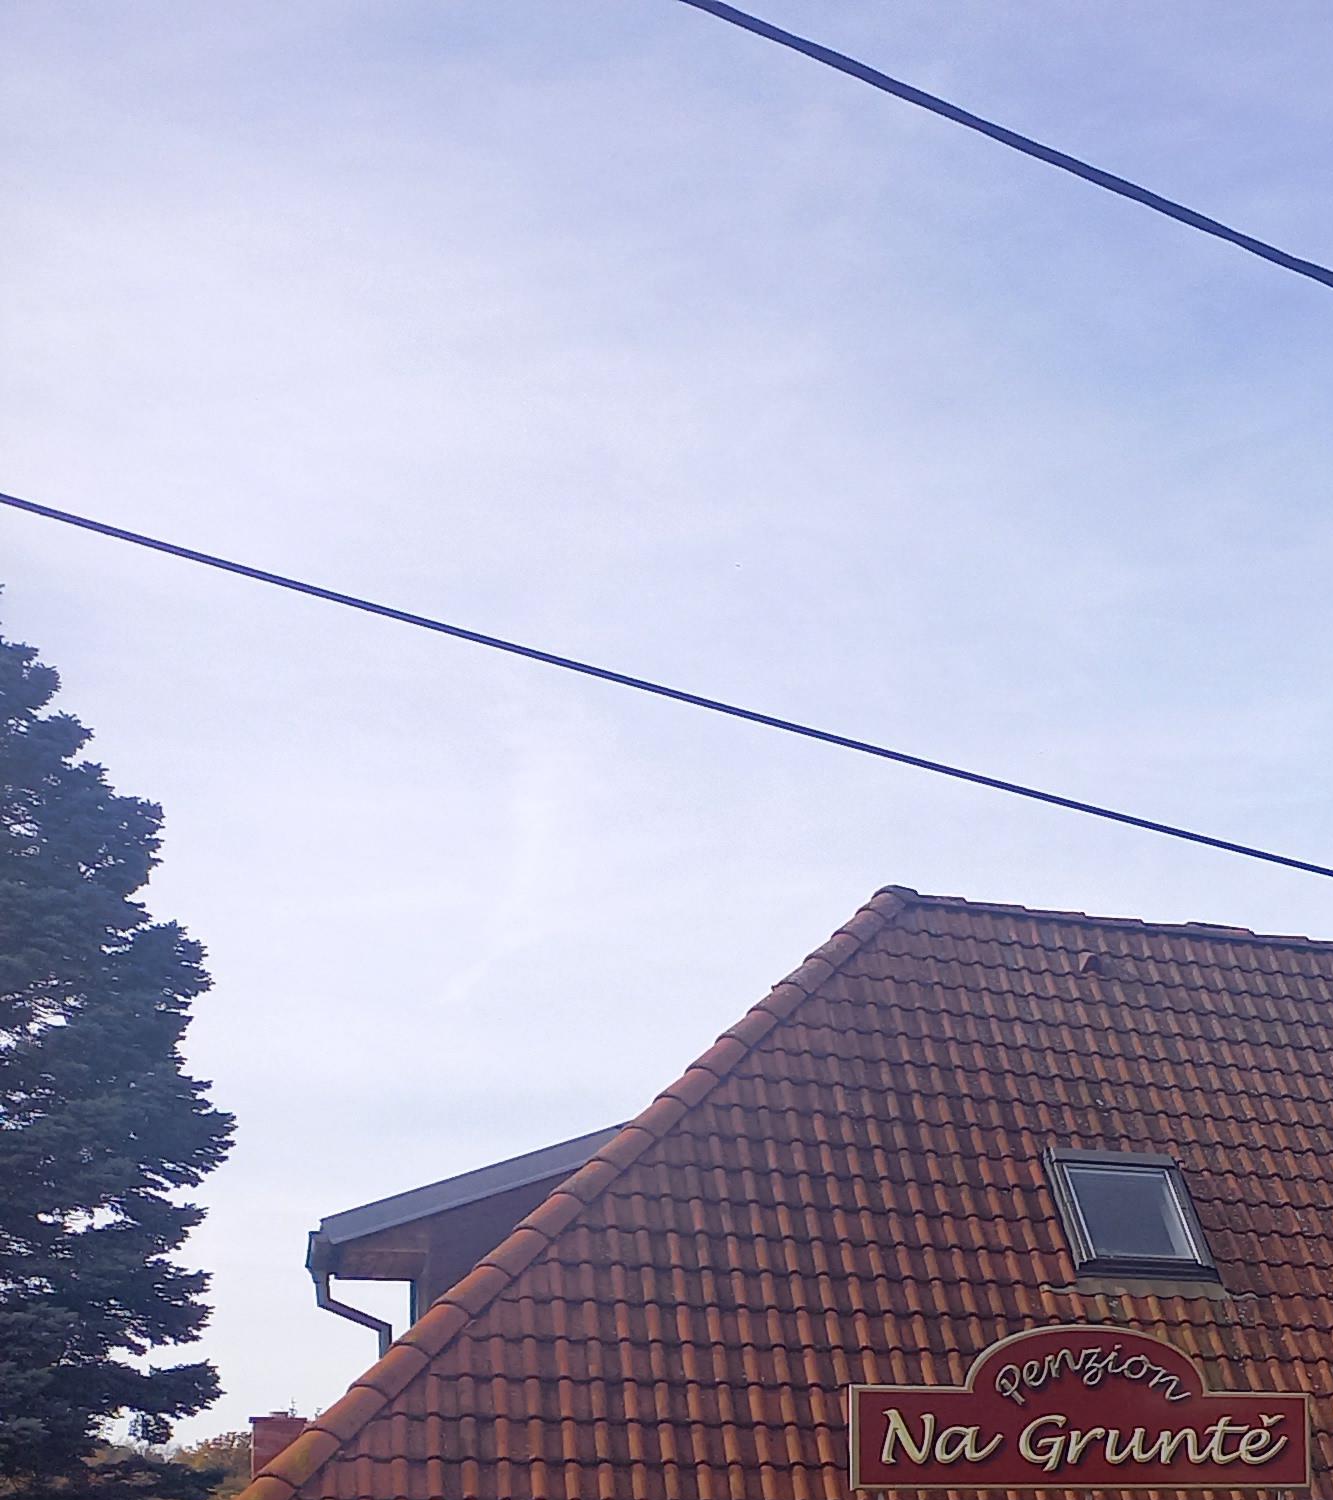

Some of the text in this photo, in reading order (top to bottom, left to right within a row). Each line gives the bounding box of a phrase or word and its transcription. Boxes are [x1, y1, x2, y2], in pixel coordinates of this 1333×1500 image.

[996, 1345, 1191, 1405] Penzion
[881, 1408, 1288, 1472] Na Gruntě
